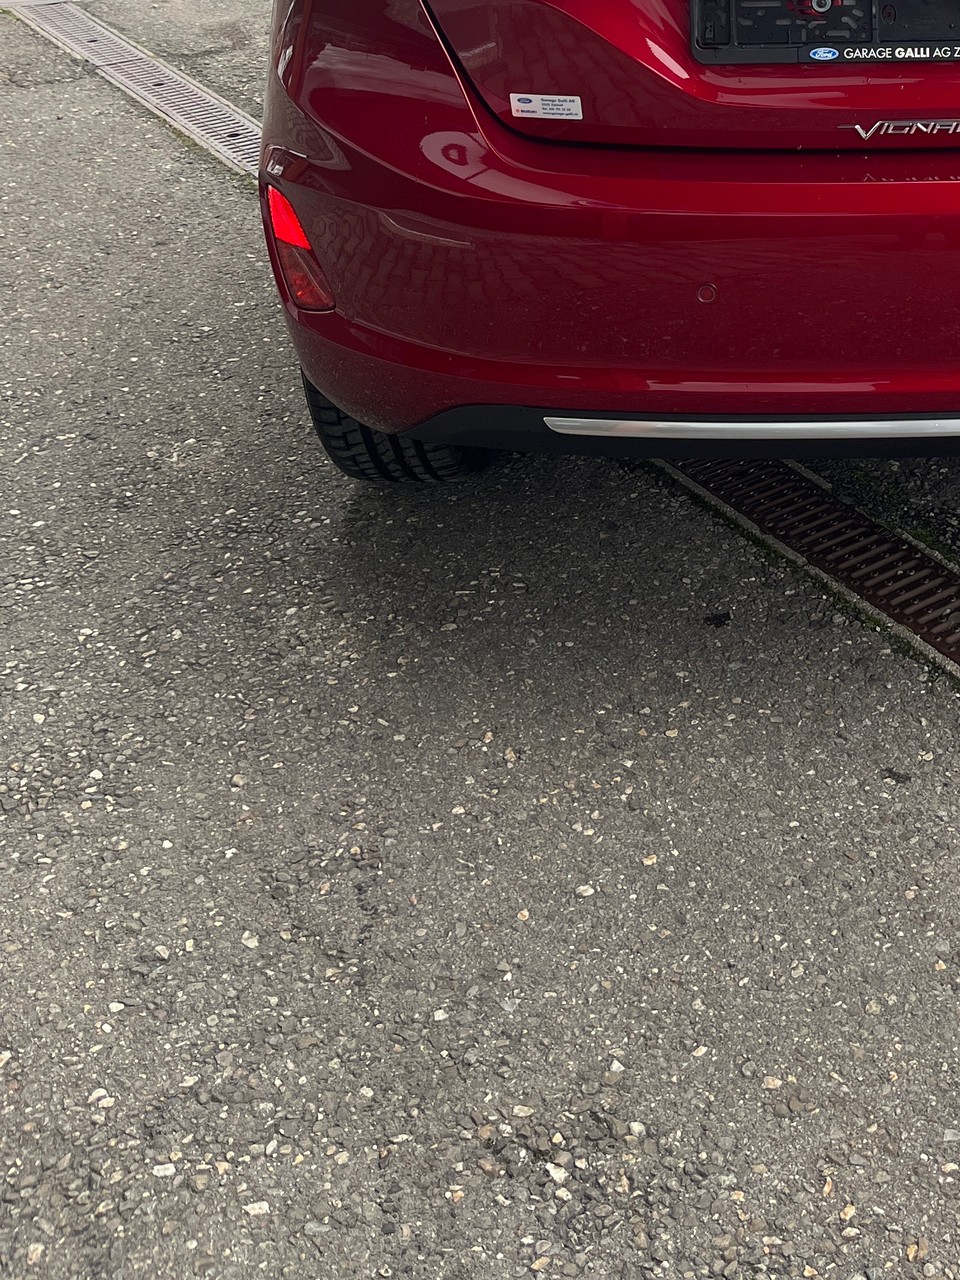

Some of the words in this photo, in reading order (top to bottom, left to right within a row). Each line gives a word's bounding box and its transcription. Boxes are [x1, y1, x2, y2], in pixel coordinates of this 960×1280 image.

[815, 49, 834, 59] Ford
[844, 47, 892, 58] GARAGE
[894, 47, 930, 58] GALLI
[933, 46, 951, 58] AG
